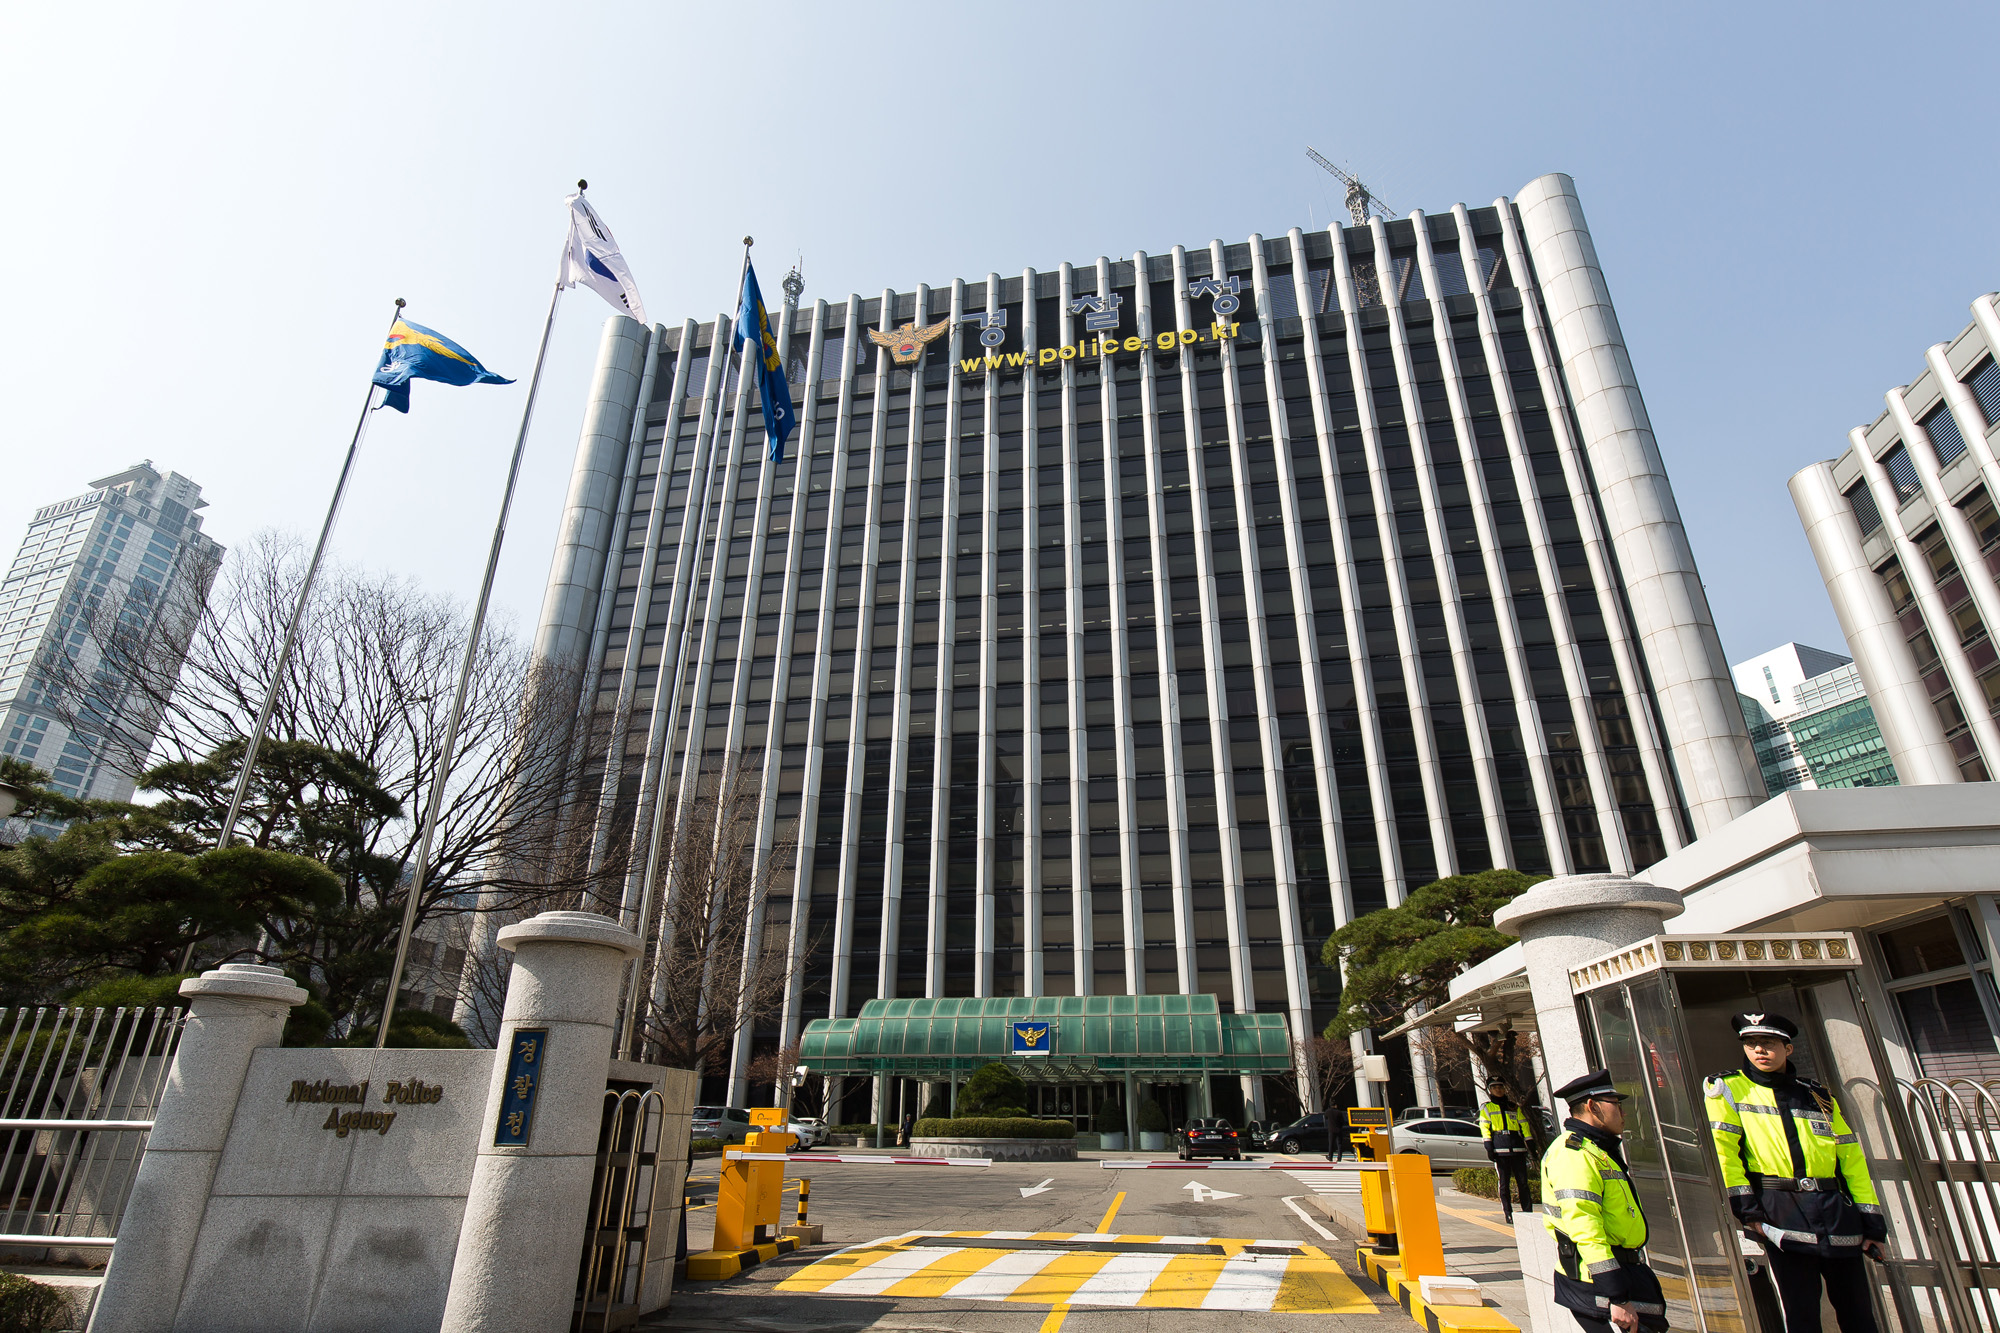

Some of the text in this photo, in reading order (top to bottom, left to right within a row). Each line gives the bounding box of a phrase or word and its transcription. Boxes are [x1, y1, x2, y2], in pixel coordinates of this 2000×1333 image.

[960, 321, 1241, 373] www.police.go.kr
[286, 1077, 443, 1104] National Police
[505, 1040, 537, 1136] 경찰청
[323, 1108, 396, 1137] Agency
